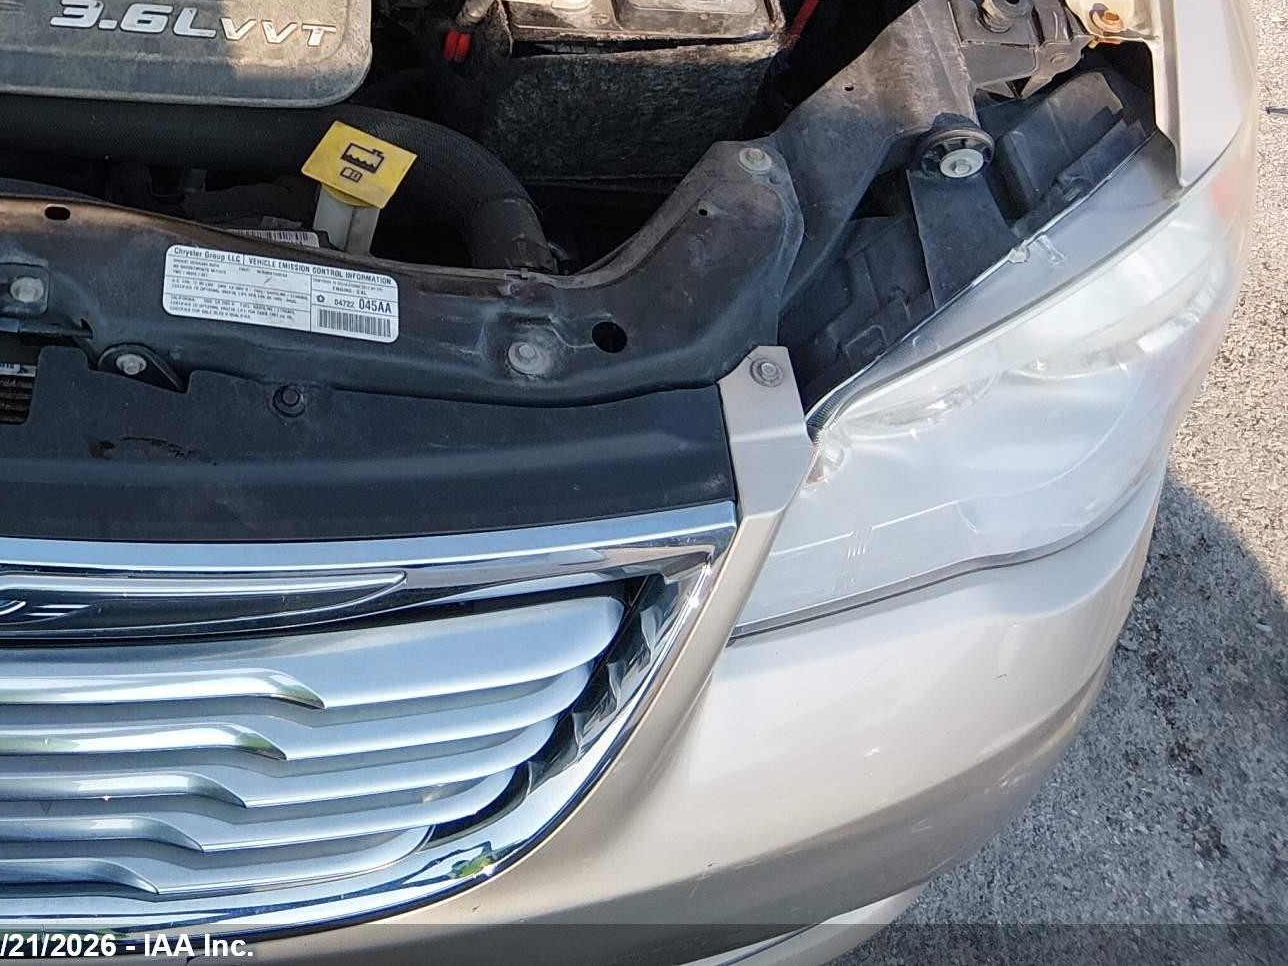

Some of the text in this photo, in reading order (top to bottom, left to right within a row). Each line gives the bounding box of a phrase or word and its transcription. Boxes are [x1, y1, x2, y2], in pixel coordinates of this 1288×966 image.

[220, 16, 337, 46] VVT
[174, 247, 241, 264] Chrysler Group LLC
[248, 257, 276, 268] VEHICLE
[278, 260, 310, 274] EMISSION
[312, 265, 343, 279] CONTROL
[345, 270, 392, 285] INFORMATION
[358, 298, 392, 314] 045AA
